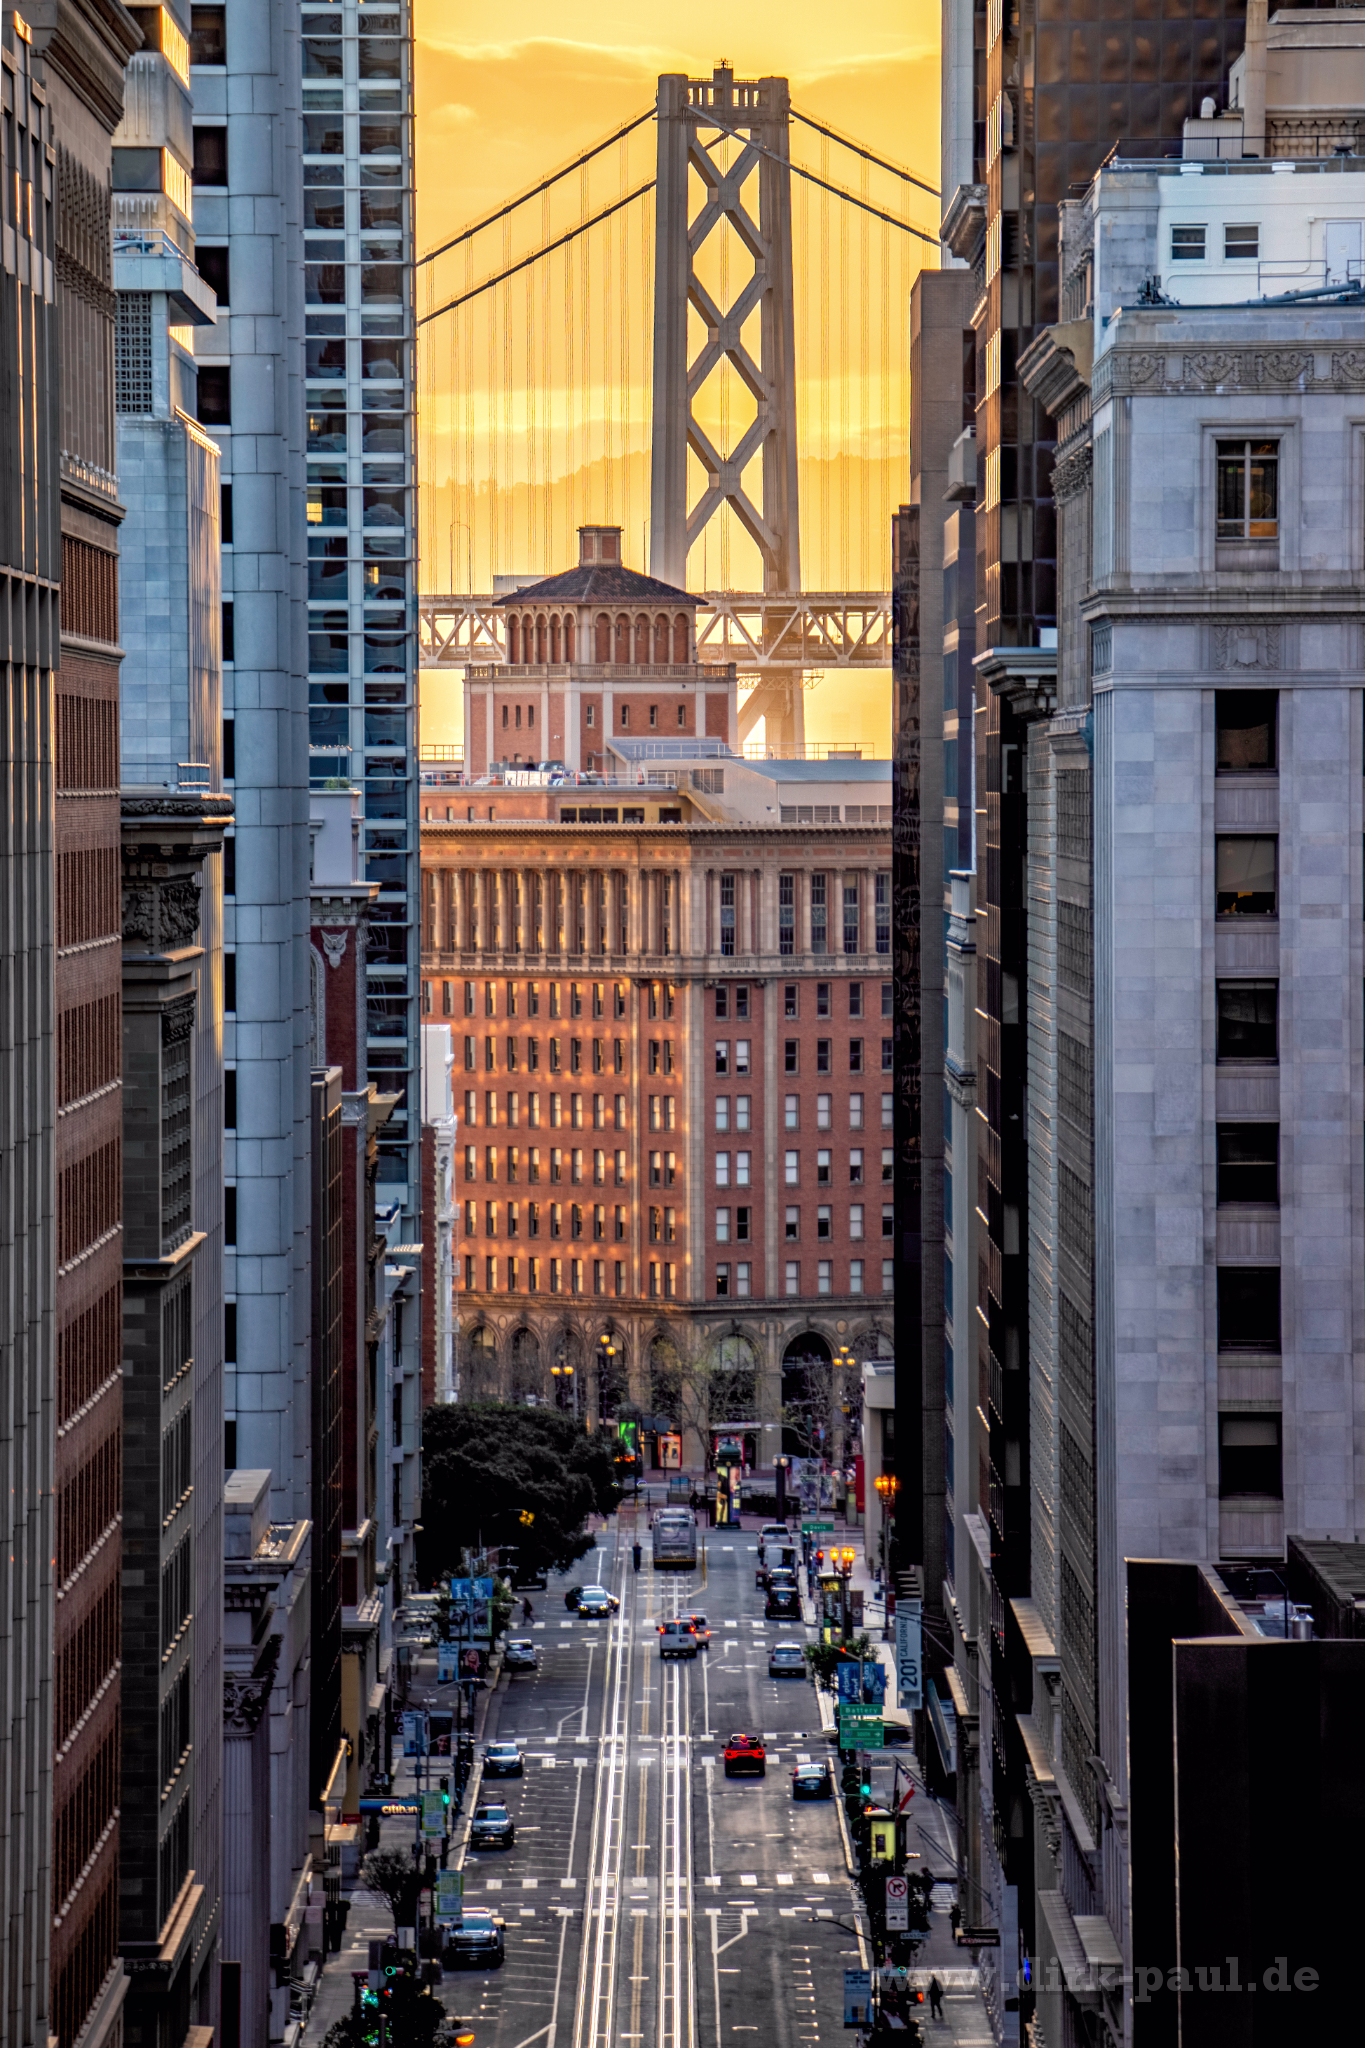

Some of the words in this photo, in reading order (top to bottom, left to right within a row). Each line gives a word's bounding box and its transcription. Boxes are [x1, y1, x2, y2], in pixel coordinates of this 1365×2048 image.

[899, 1616, 908, 1657] CALIFORNIA
[900, 1658, 918, 1688] 201
[381, 1804, 418, 1814] citiban
